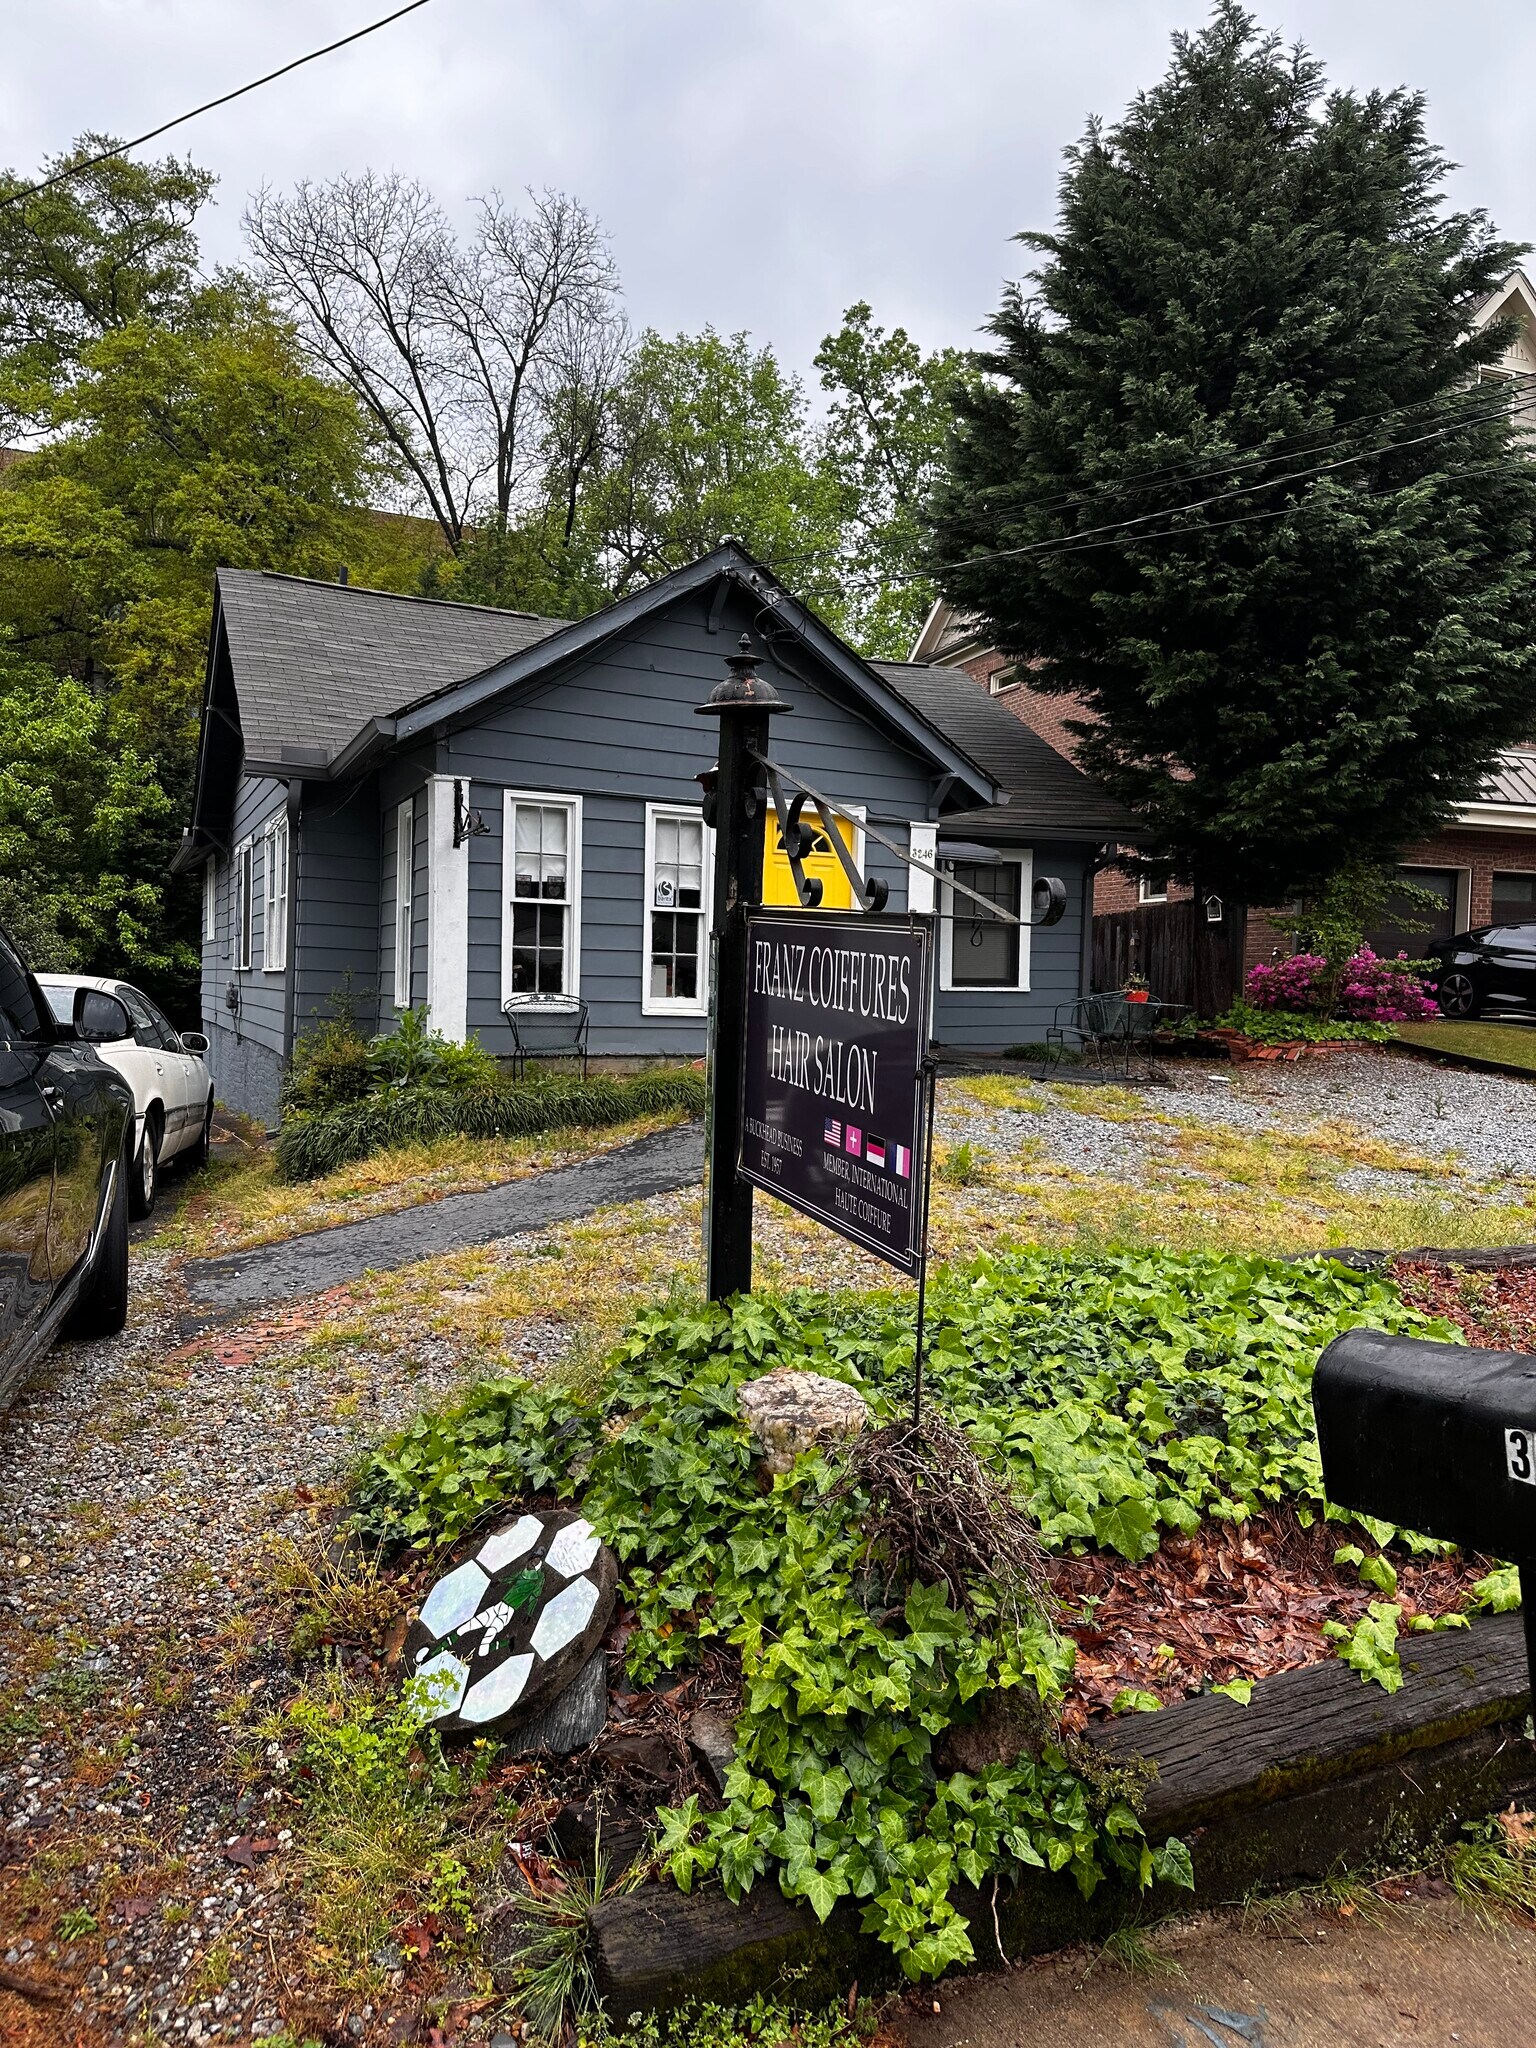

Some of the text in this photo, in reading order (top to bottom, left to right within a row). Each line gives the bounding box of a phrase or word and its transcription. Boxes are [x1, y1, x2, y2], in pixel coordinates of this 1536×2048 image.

[912, 848, 933, 859] 3246
[754, 940, 911, 1025] FRANZ COIFFURES
[770, 1024, 878, 1115] HAIR SALON
[744, 1116, 803, 1158] A BUCKHEAD BUSINESS
[771, 1155, 783, 1175] 1957
[851, 1164, 908, 1209] INTERNATIONAL
[835, 1187, 892, 1234] HAUTE COIFFURE
[1509, 1430, 1531, 1480] 3
